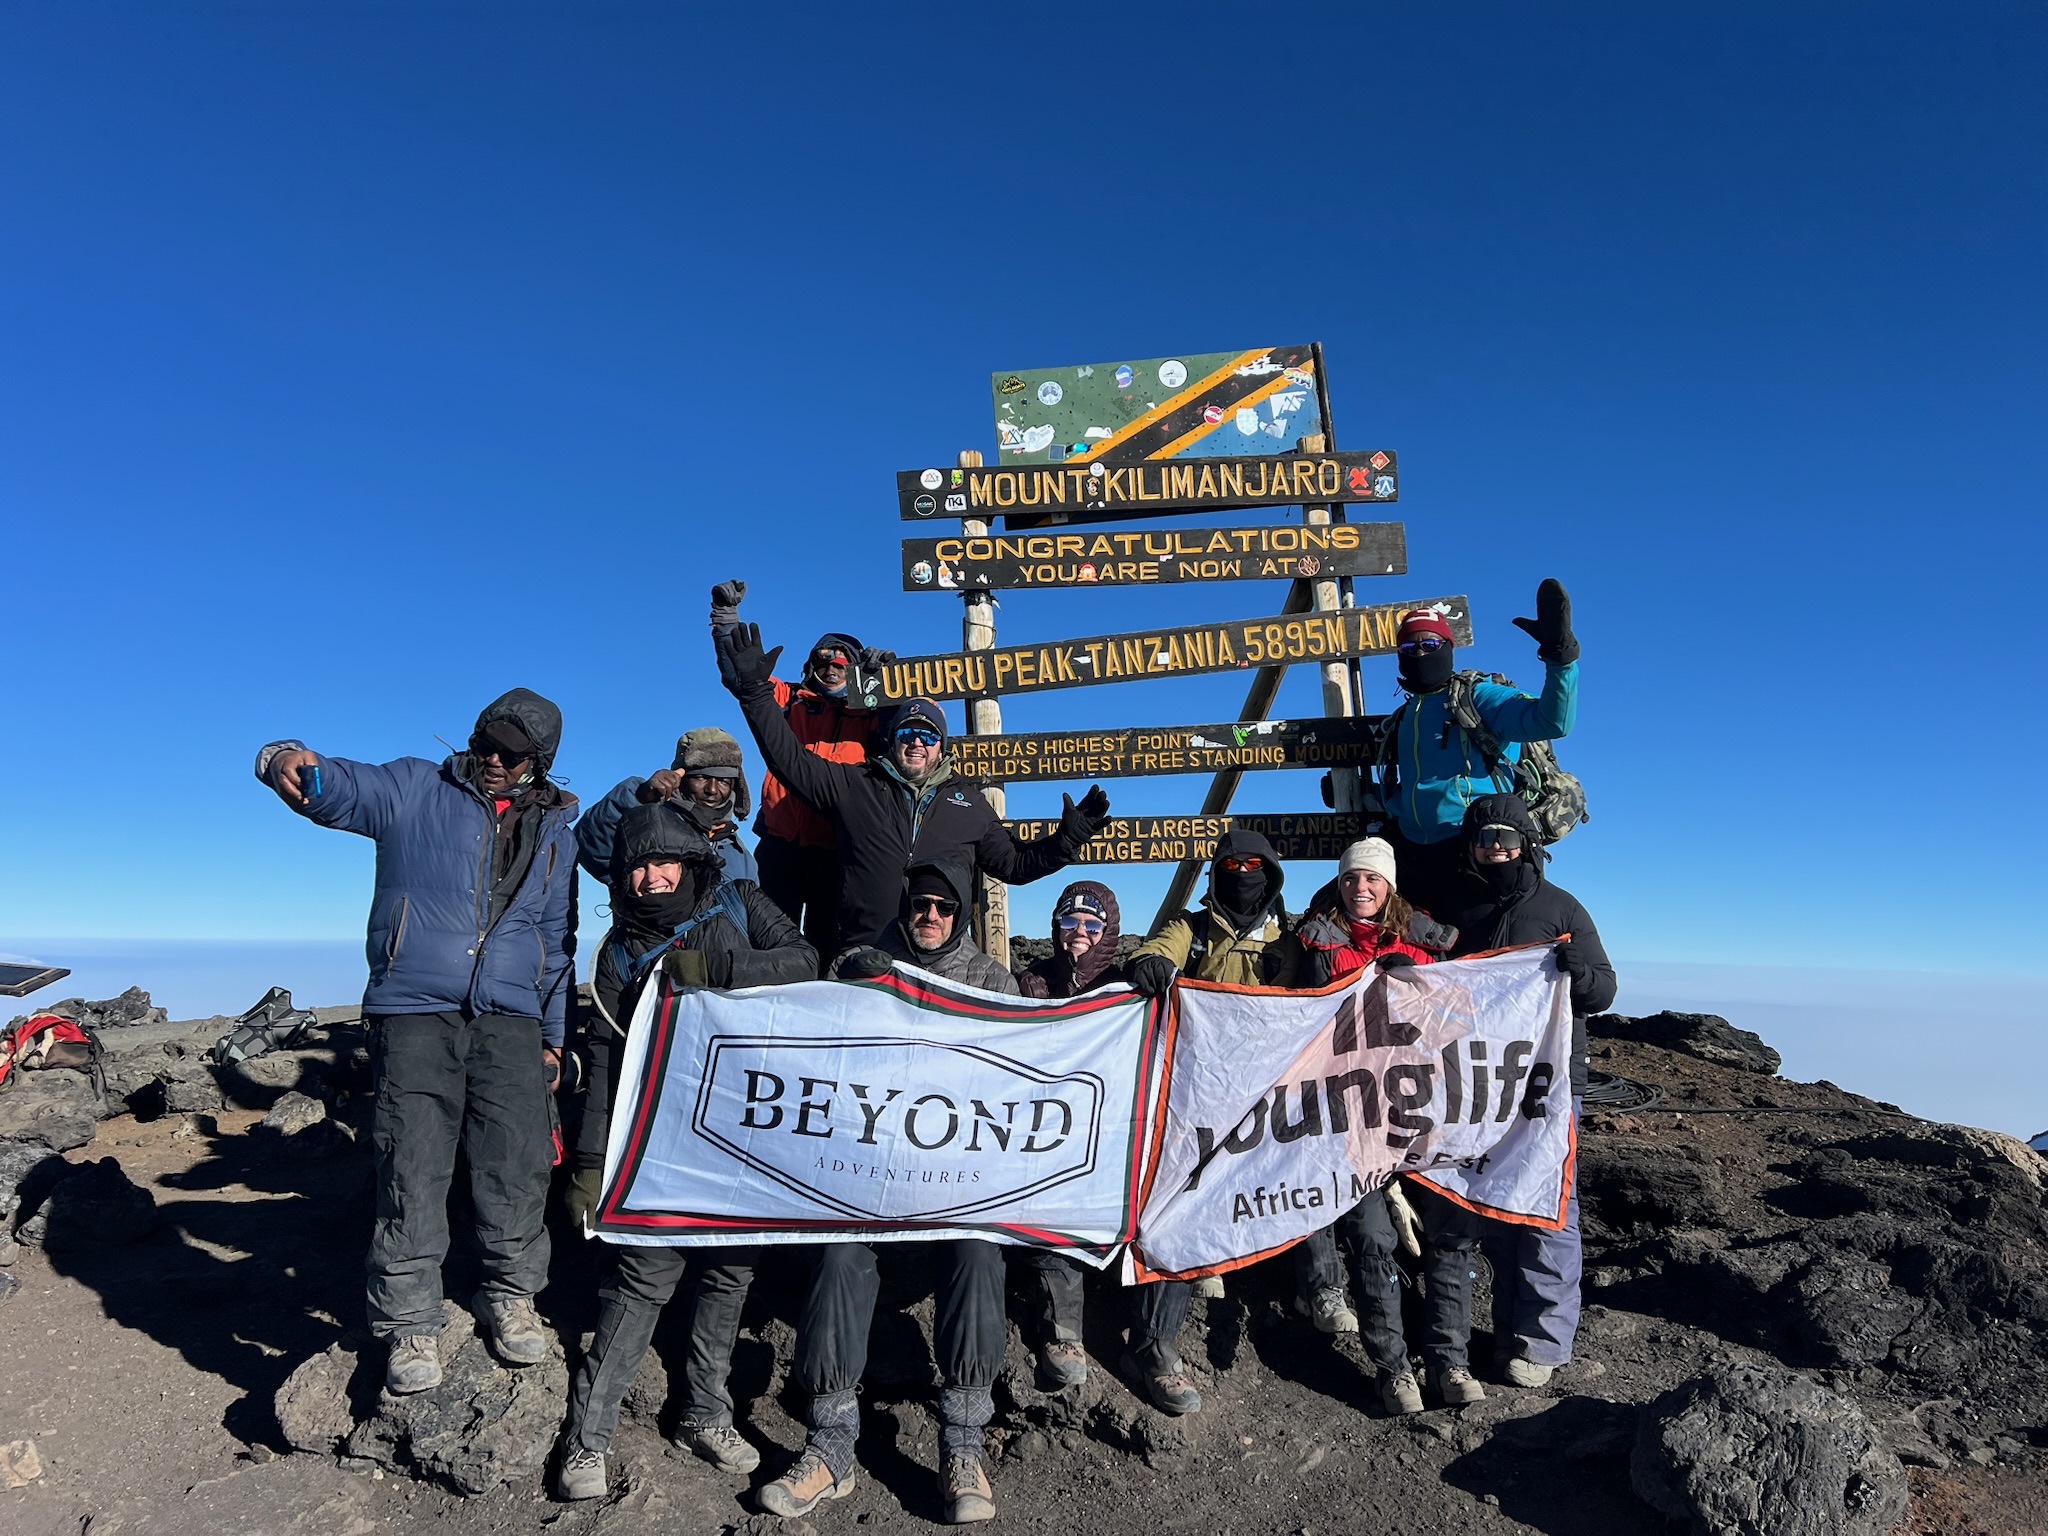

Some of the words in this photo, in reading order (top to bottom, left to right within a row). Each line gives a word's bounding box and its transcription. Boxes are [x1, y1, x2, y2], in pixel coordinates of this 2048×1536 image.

[970, 470, 1090, 506] MOUNT
[1104, 460, 1341, 501] KILIMANJARO
[935, 527, 1360, 561] CONGRATULATIONS
[1019, 564, 1078, 583] YOU
[1099, 562, 1159, 580] ARE
[1179, 560, 1241, 578] NOW
[1262, 557, 1297, 575] AT
[881, 656, 987, 699] UHURU
[993, 646, 1084, 689] PEAK,
[1243, 615, 1348, 662] 5895M
[951, 741, 1038, 759] AFRICAS
[1044, 736, 1126, 755] HIGHEST
[1137, 732, 1195, 750] POINT
[1038, 755, 1125, 774] HIGHEST
[1132, 751, 1185, 770] FREE
[1188, 745, 1286, 767] STANDING
[1019, 822, 1042, 840] OF
[1135, 817, 1233, 839] LARGEST
[1240, 815, 1360, 836] VOLCANOES
[1149, 841, 1187, 859] AND
[1276, 838, 1300, 858] OF
[739, 1069, 1072, 1153] BEYOND
[814, 1156, 983, 1184] ADVENTURES
[1232, 1182, 1324, 1224] Africa
